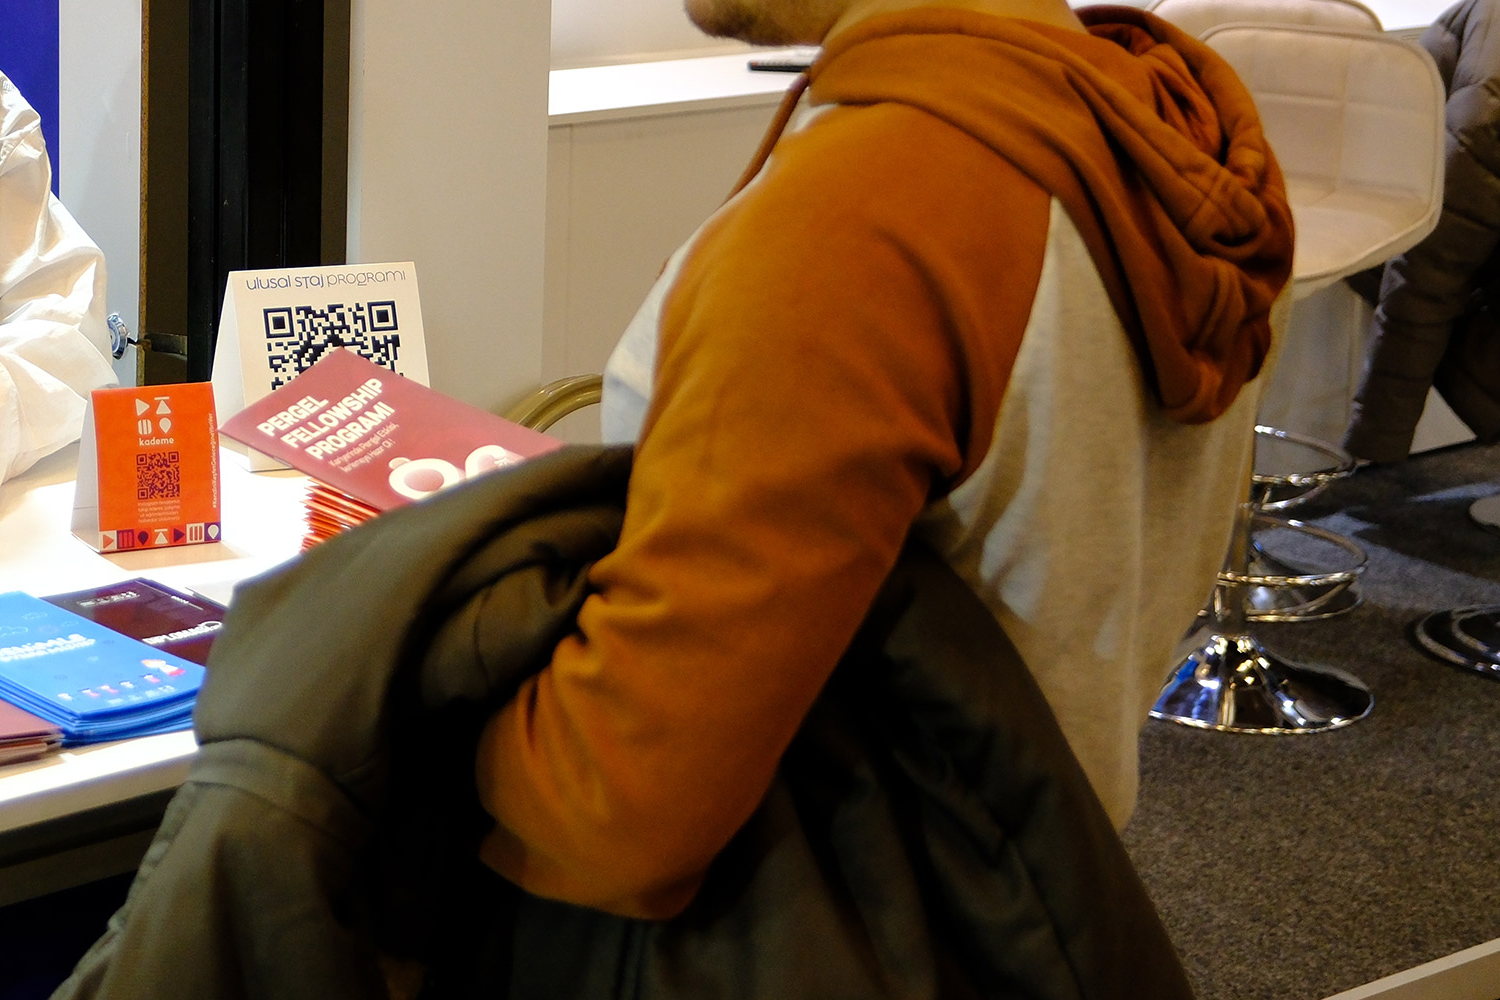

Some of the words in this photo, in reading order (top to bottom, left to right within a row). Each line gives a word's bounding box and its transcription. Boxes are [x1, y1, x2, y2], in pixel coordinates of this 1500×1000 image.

[246, 274, 291, 291] ulusal
[256, 395, 329, 437] PERGEL
[280, 377, 383, 449] FELLOWSHIP
[304, 401, 396, 460] PROGRAMI
[138, 437, 175, 447] kademe
